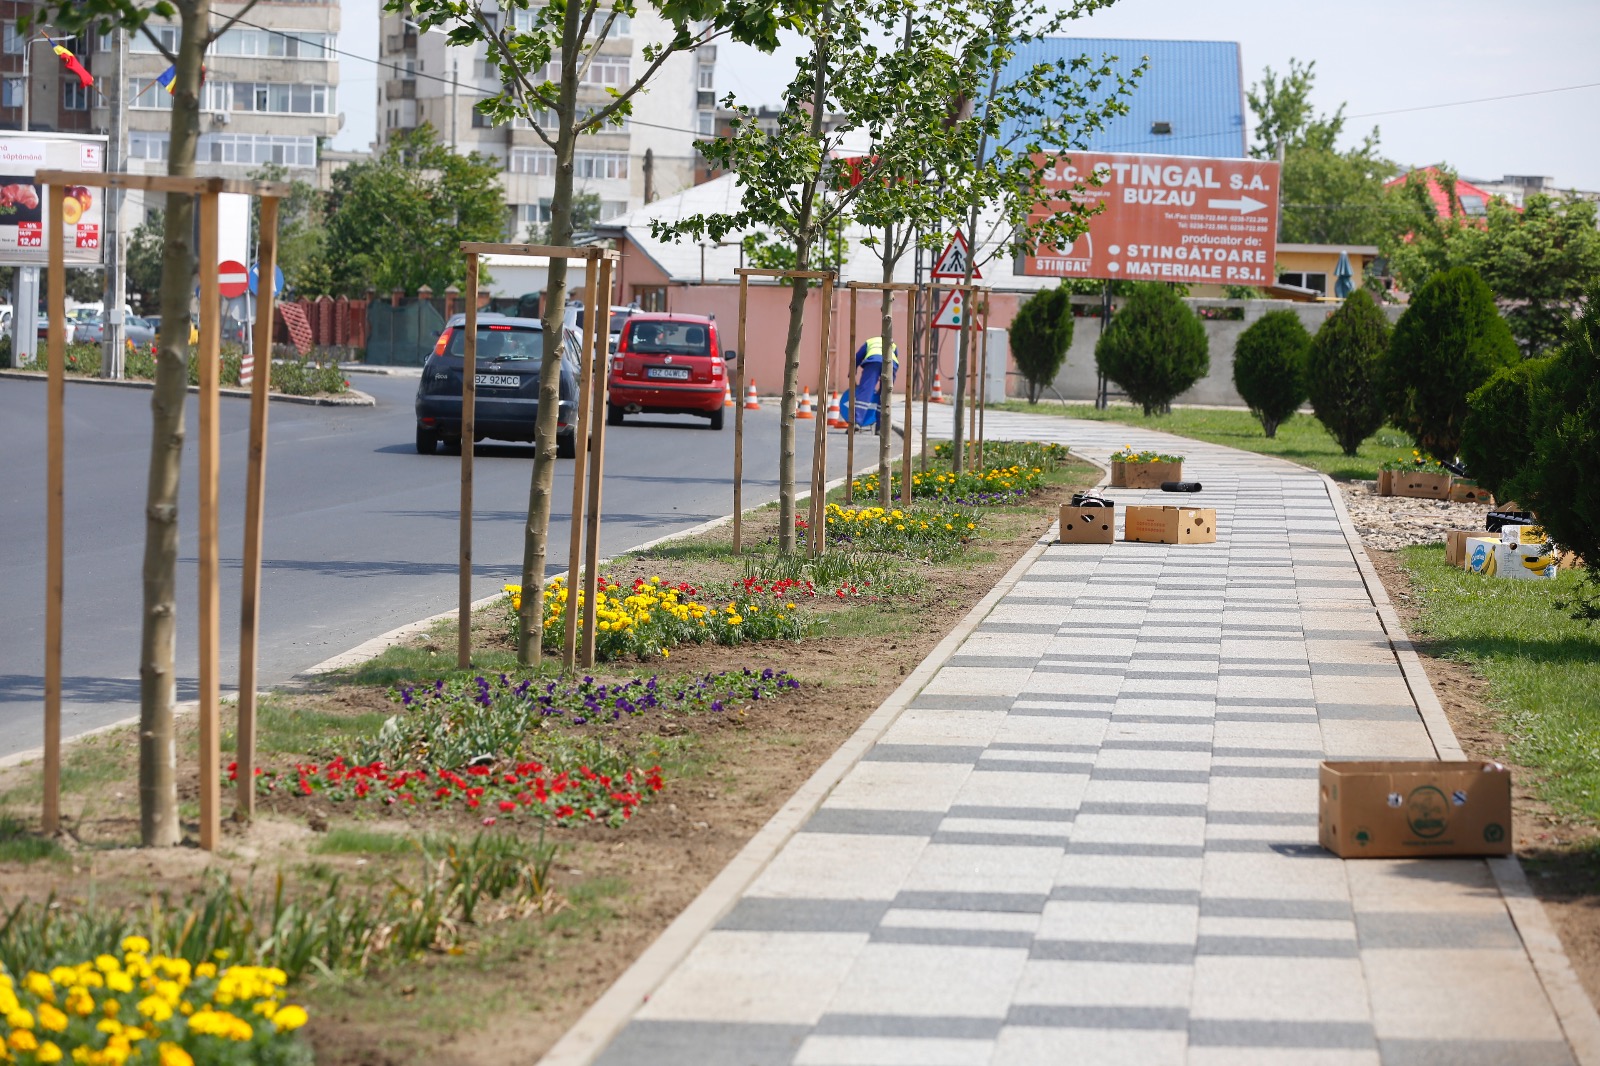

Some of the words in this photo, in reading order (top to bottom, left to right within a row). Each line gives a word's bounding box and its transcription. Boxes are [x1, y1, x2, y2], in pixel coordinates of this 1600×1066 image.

[1043, 166, 1084, 182] S.C.
[1093, 162, 1221, 189] STINGAL
[1229, 173, 1270, 191] S.A.
[1123, 188, 1196, 207] BUZAU
[20, 237, 41, 247] 12,49
[1181, 234, 1242, 246] producator
[1244, 236, 1262, 247] de:
[1127, 244, 1267, 263] STINGĂTOARE
[1036, 259, 1088, 273] STINGAL
[1126, 261, 1222, 278] MATERIALE
[1226, 266, 1266, 281] P.S.I.
[475, 375, 487, 384] BZ
[489, 375, 519, 386] 92MCC
